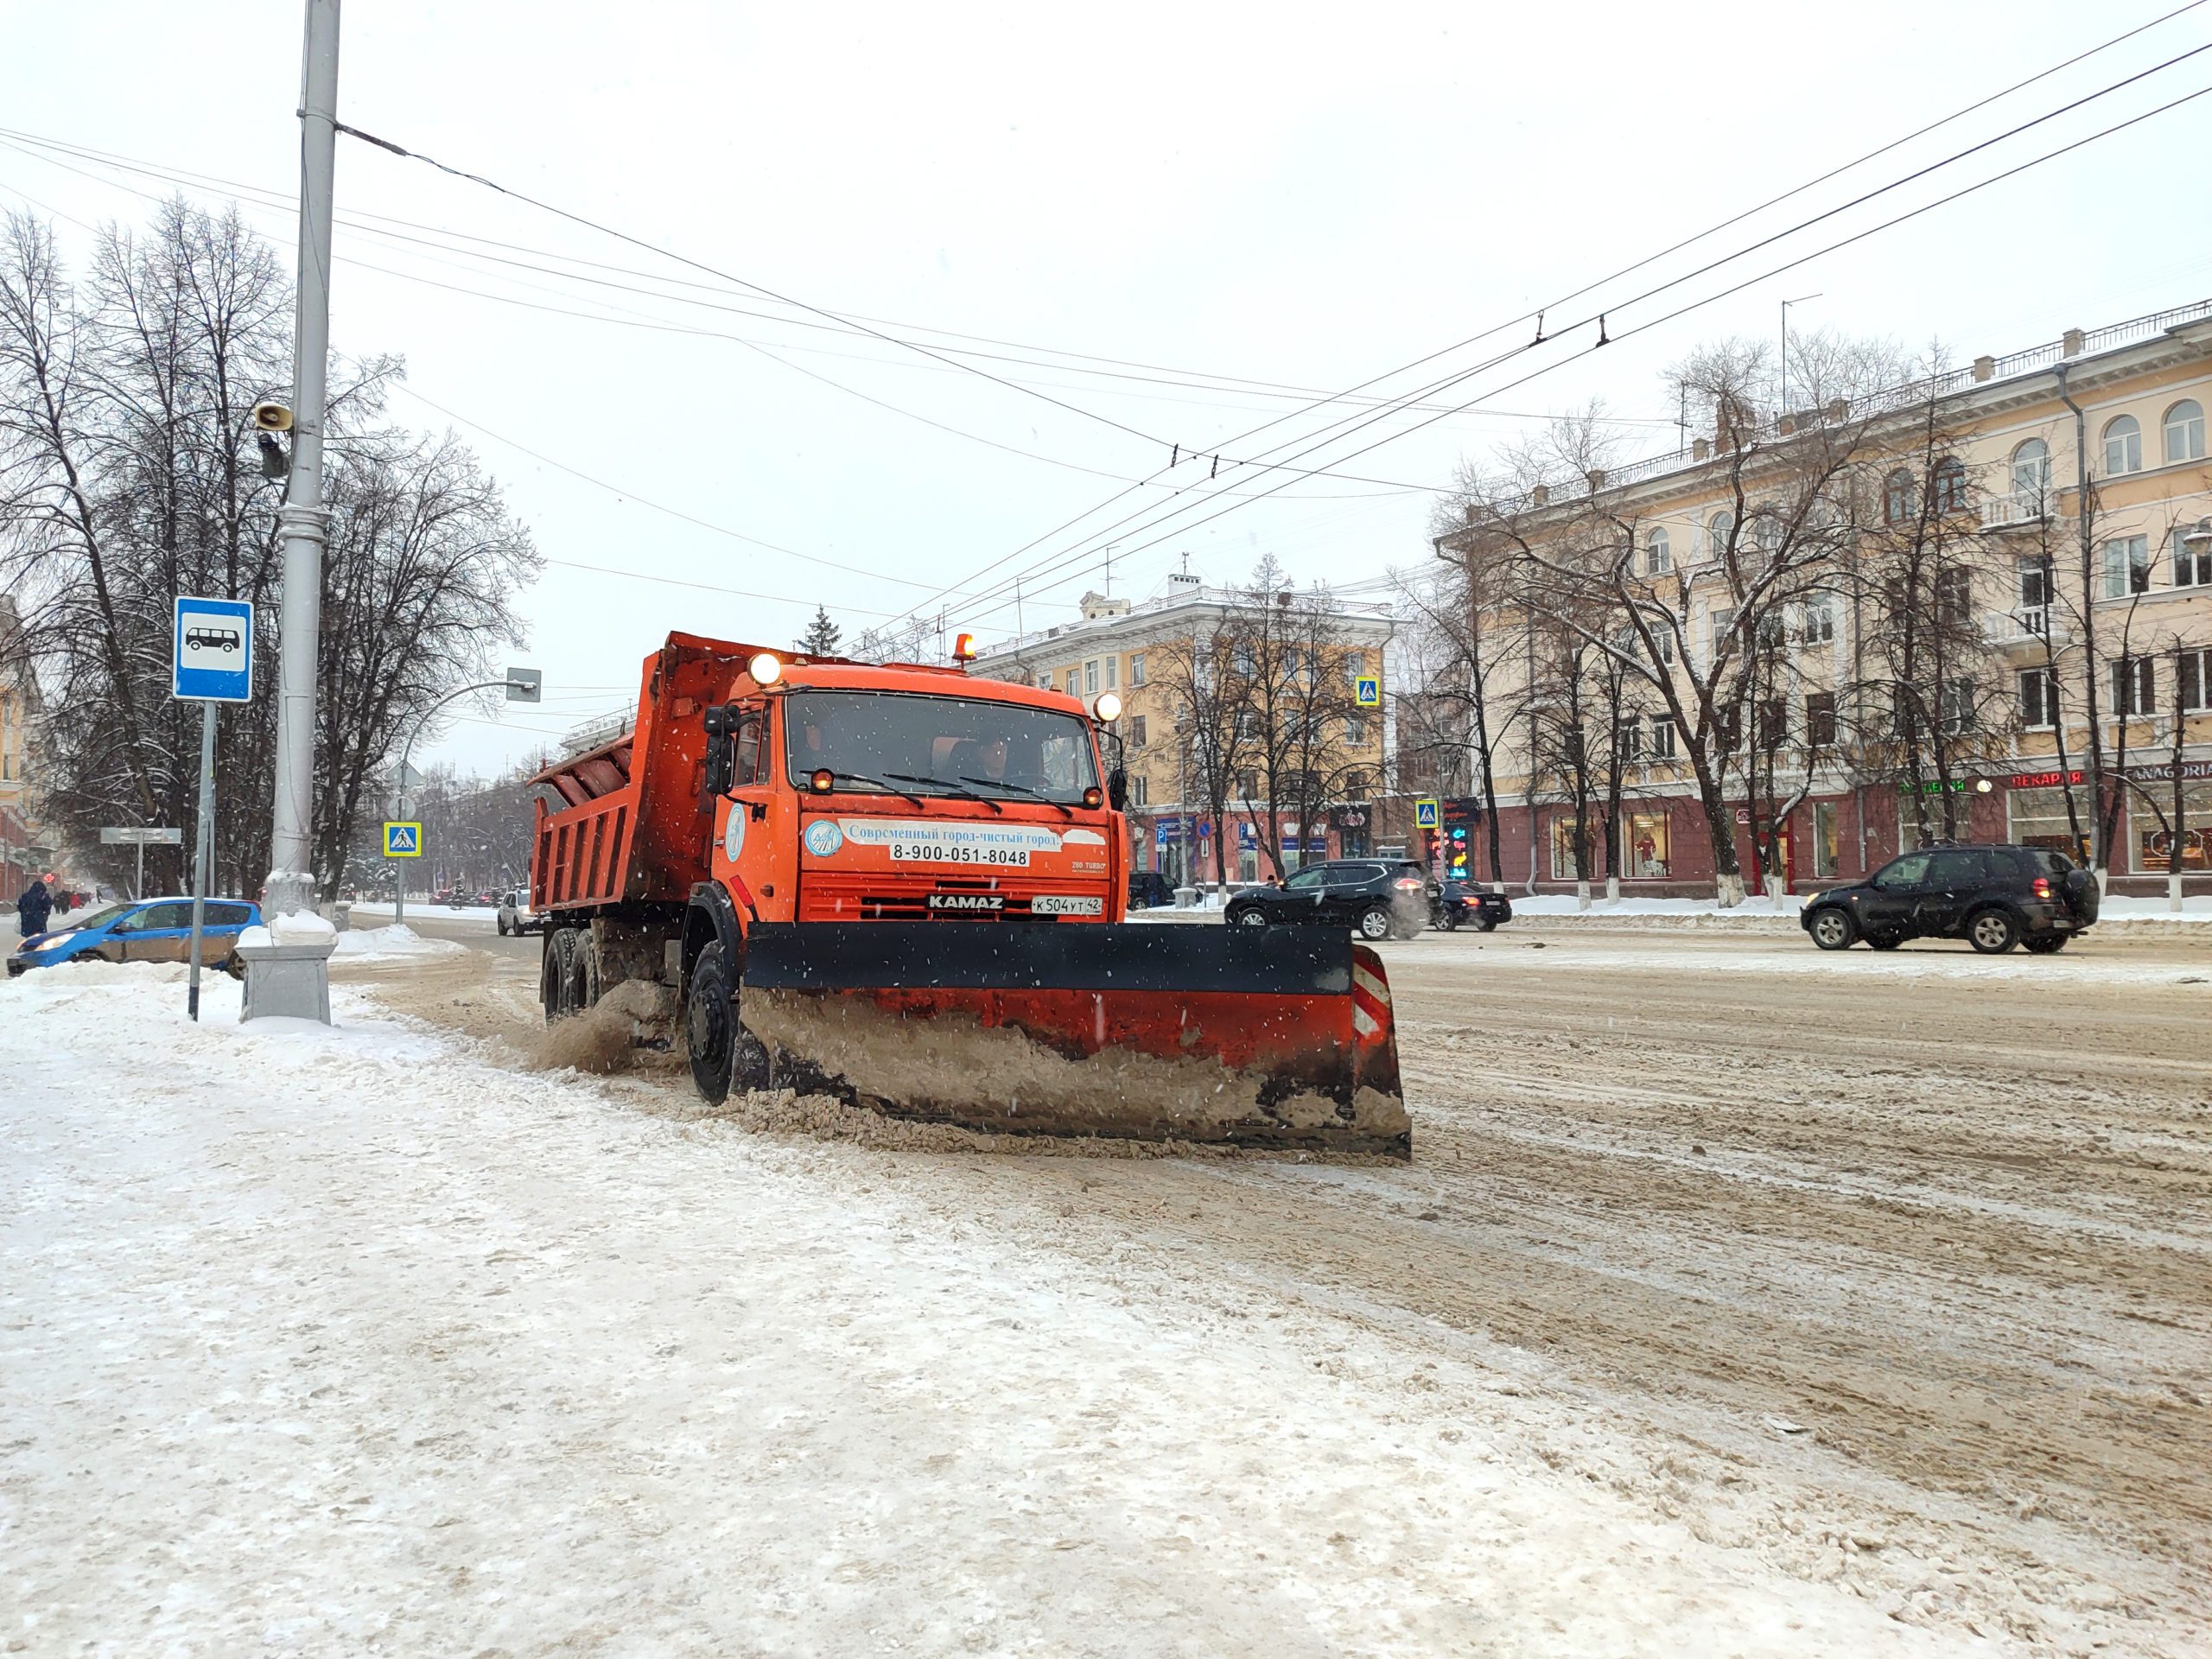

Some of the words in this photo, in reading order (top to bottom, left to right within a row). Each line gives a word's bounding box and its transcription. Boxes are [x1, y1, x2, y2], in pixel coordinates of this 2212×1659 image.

[849, 824, 939, 842] Современный
[943, 830, 1023, 844] город-чистый
[893, 844, 1027, 865] 8-900-051-8048
[929, 895, 1003, 909] KAMAZ
[1087, 899, 1099, 909] 42
